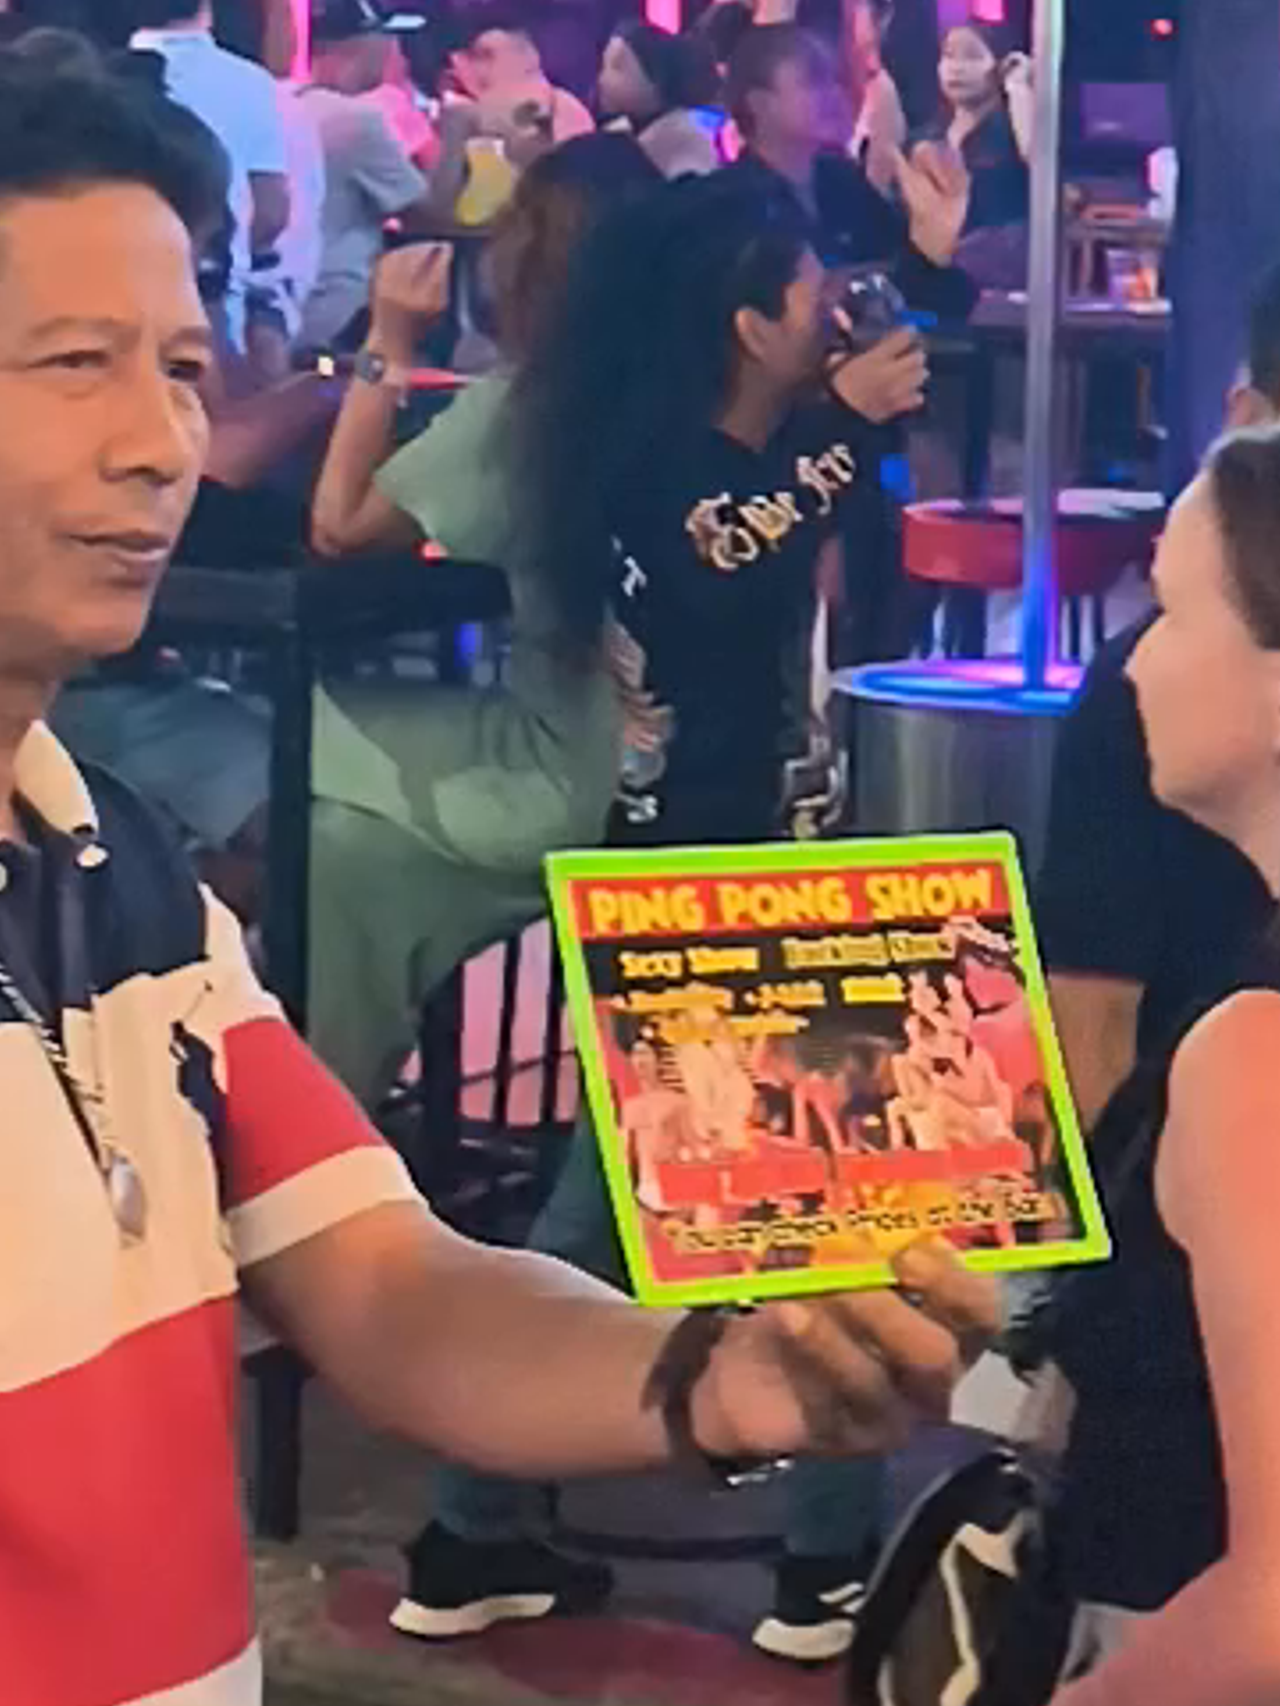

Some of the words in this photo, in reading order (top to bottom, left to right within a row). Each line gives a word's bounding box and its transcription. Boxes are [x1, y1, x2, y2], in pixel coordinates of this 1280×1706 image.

[588, 885, 705, 936] PING
[718, 875, 853, 927] PONG
[864, 867, 994, 921] SHOW
